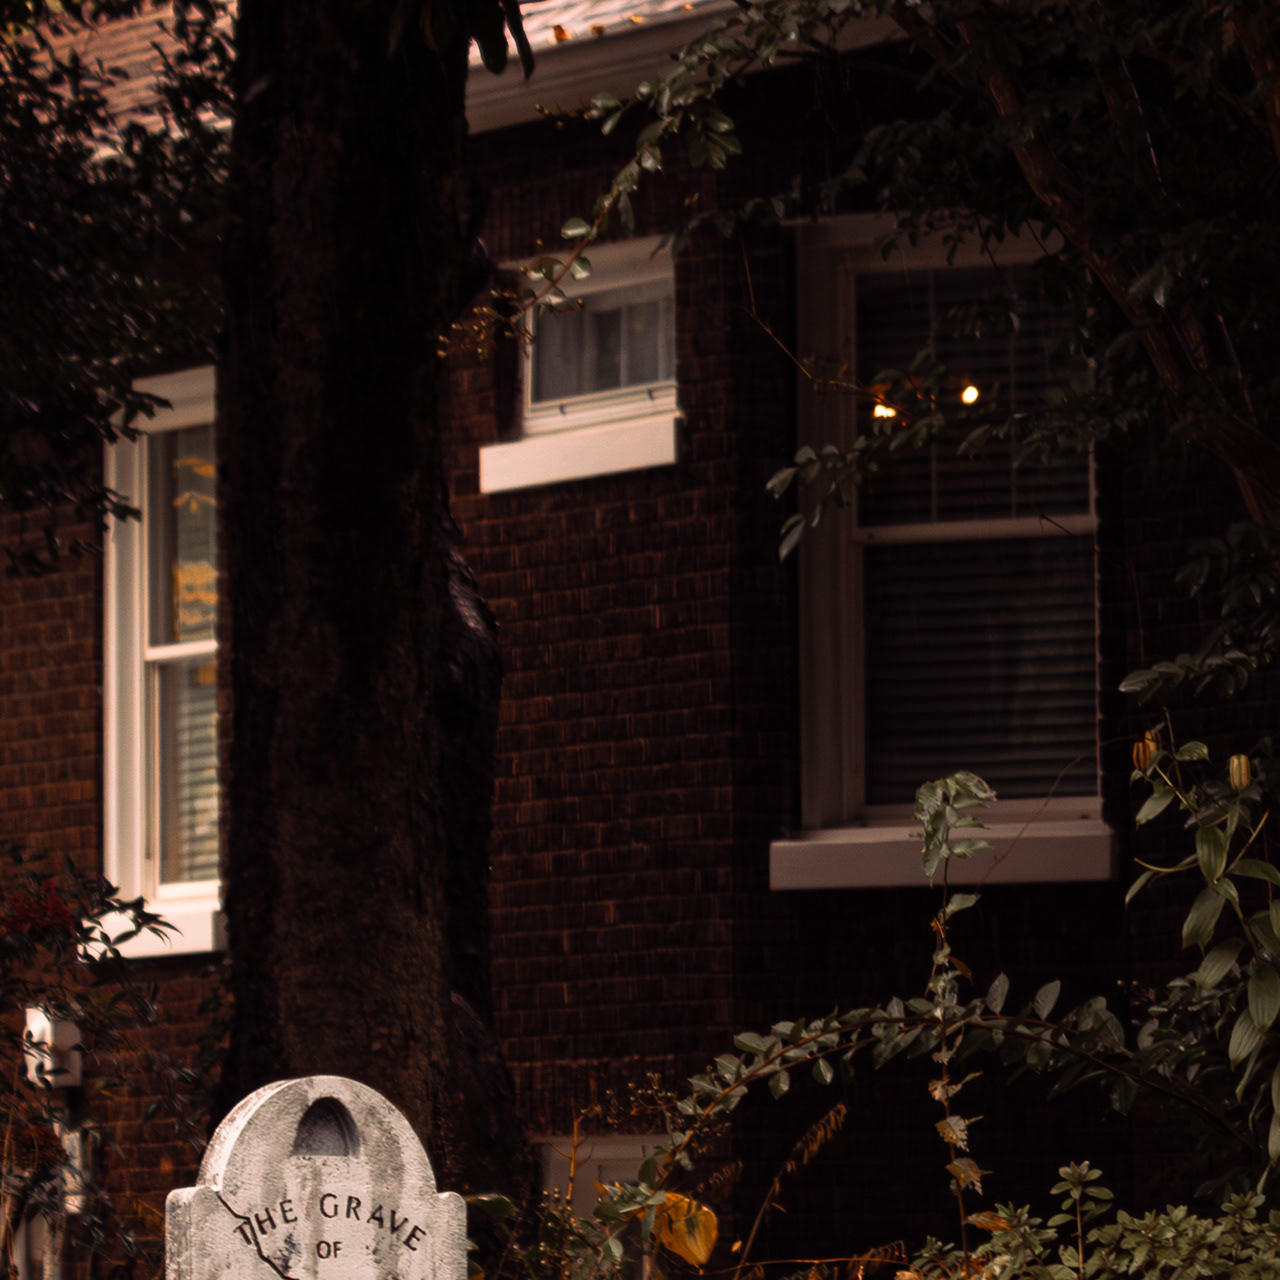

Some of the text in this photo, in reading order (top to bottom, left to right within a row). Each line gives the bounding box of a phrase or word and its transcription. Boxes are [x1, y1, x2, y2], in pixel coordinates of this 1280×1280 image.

[233, 1193, 427, 1252] THE GRAVE
[316, 1240, 343, 1259] OF
